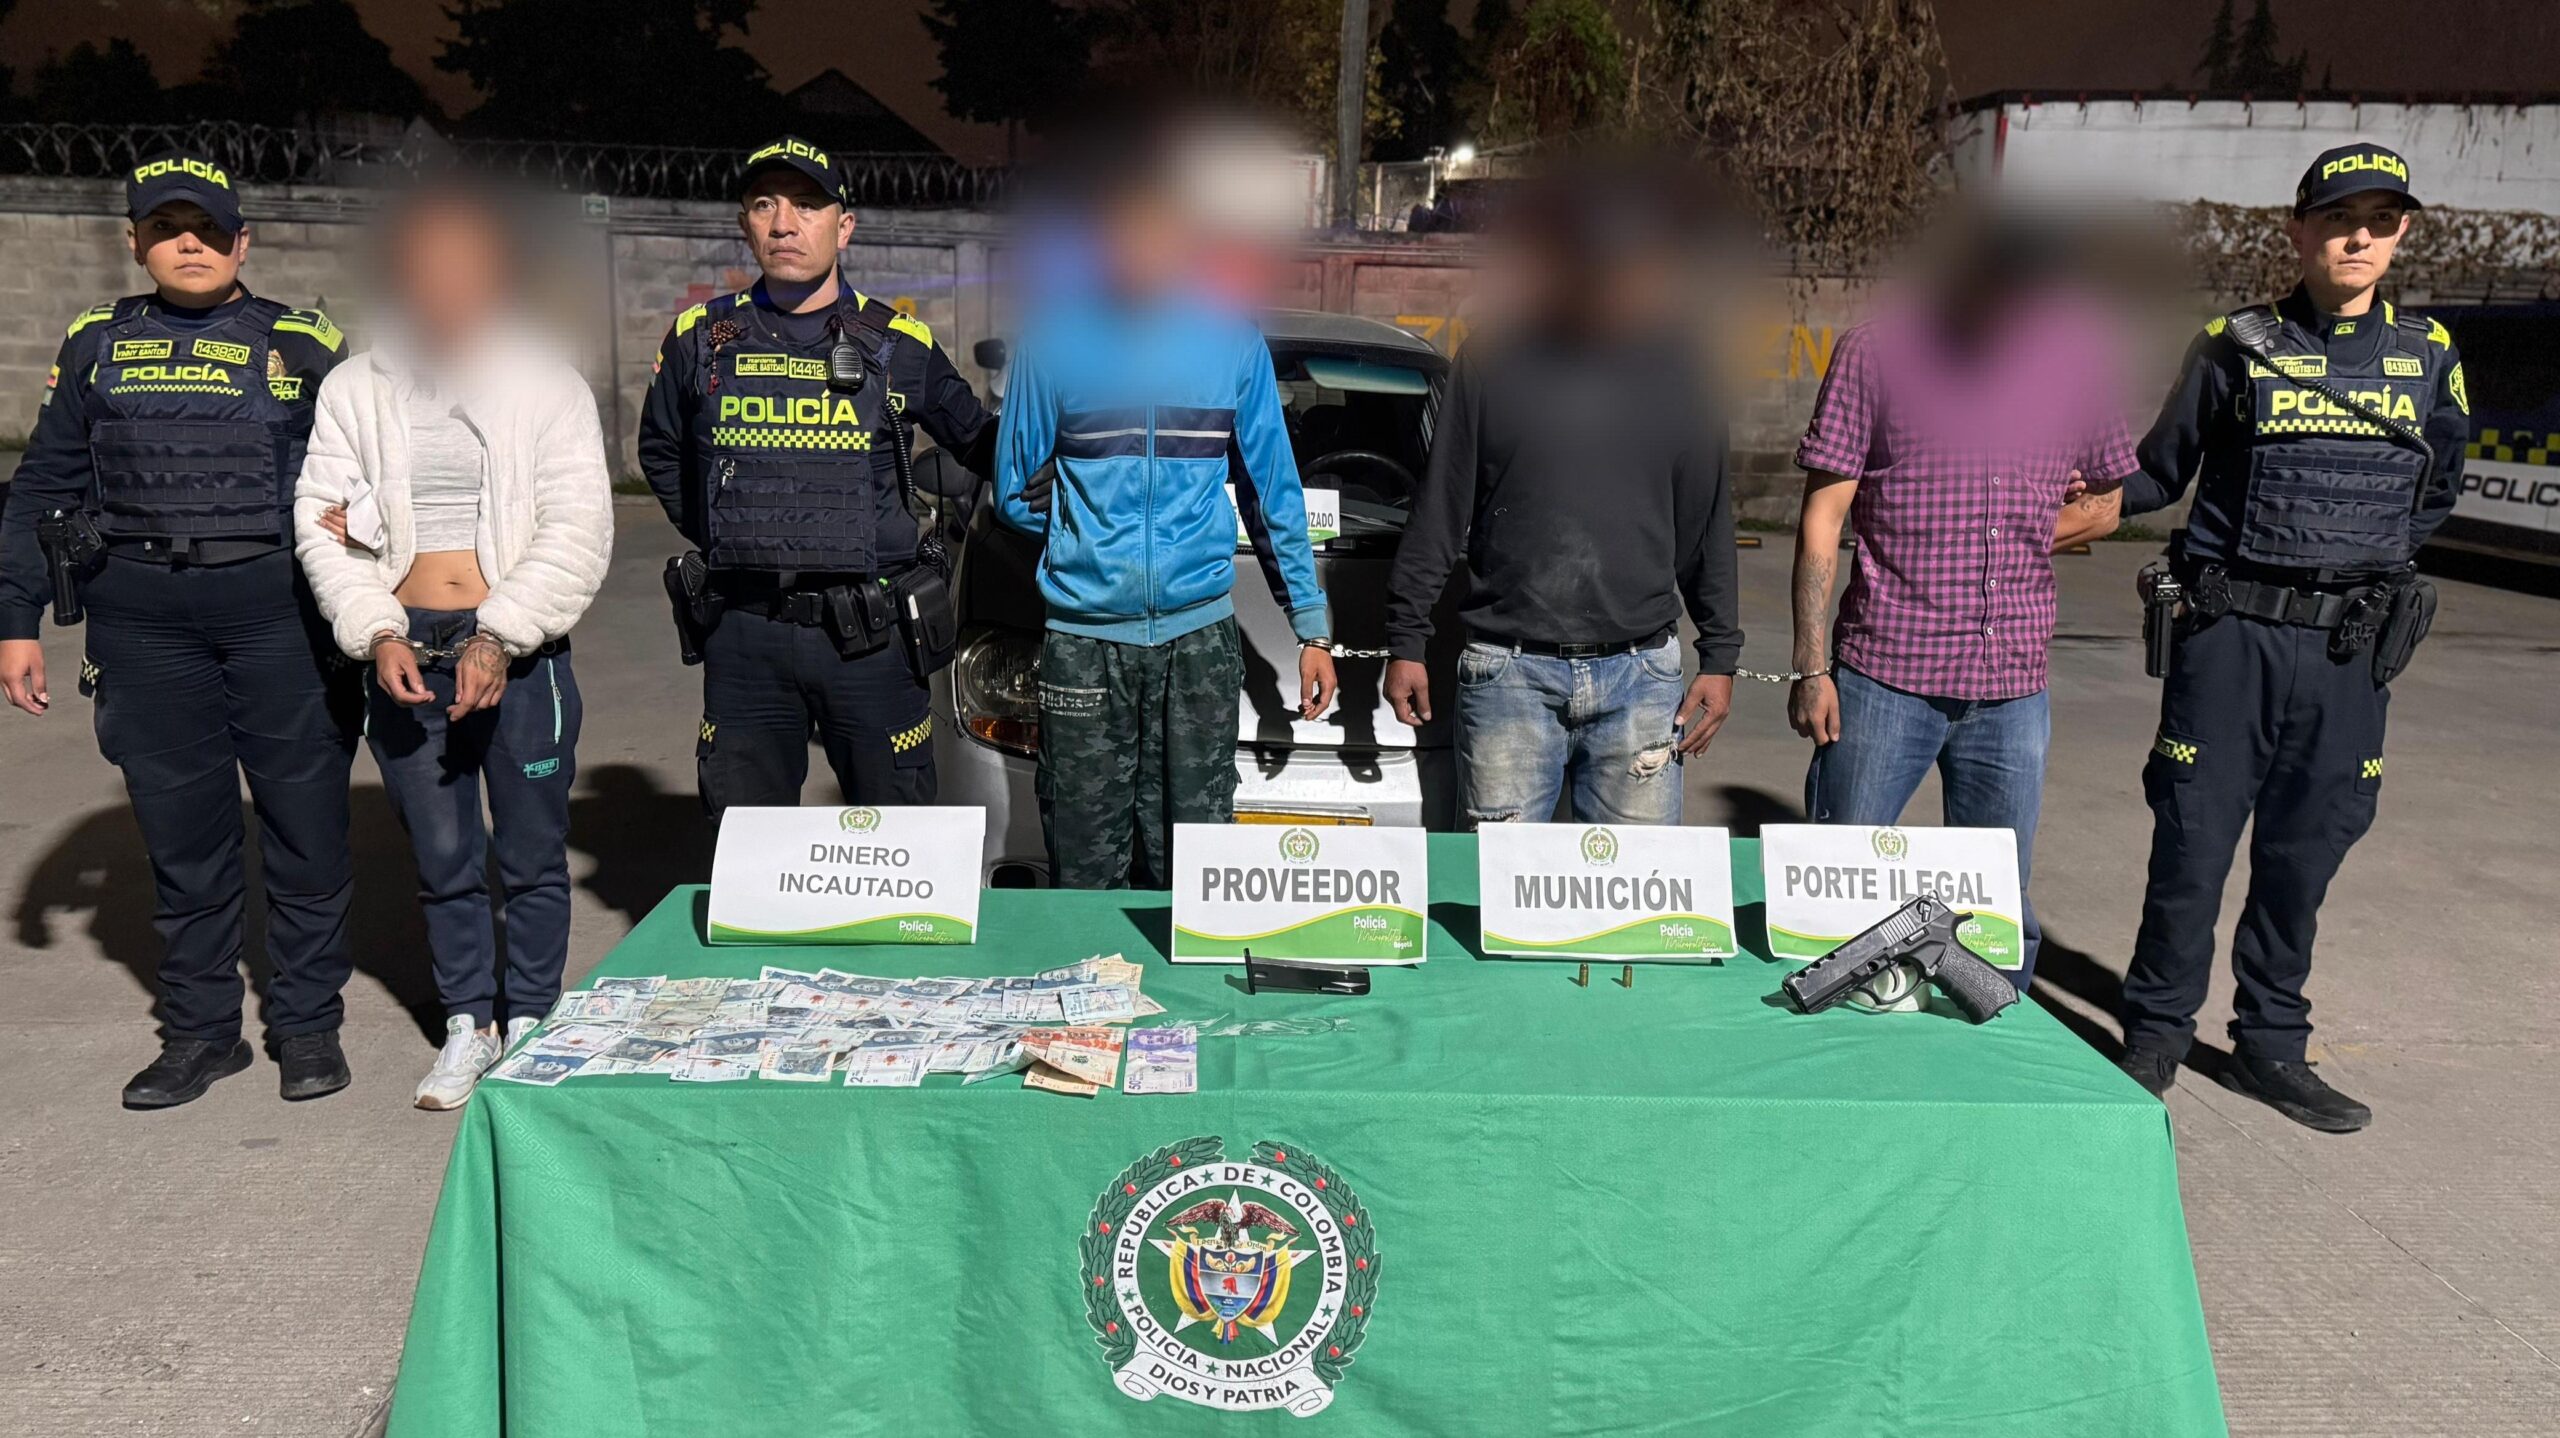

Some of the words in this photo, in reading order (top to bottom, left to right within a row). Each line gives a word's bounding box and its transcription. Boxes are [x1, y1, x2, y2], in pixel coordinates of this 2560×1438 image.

[747, 139, 828, 170] POLICÍA
[2323, 154, 2407, 182] POLICÍA
[134, 158, 229, 189] POLICÍA
[198, 343, 245, 361] 143920
[121, 363, 230, 383] POLICÍA
[792, 362, 827, 377] 14412
[720, 389, 859, 425] POLICÍA
[2459, 474, 2560, 507] POLIC
[810, 844, 910, 867] DINERO
[779, 872, 934, 899] INCAUTADO
[1202, 867, 1401, 904] PROVEEDOR
[1514, 869, 1693, 912] MUNICIÓN
[1785, 865, 1878, 900] PORTE
[1889, 868, 1993, 905] ILEGAL
[899, 920, 933, 932] Policía
[1353, 915, 1387, 929] Policía
[1660, 924, 1693, 937] Policía
[1956, 921, 1982, 934] olicía
[1118, 1174, 1200, 1278] REPÚBLICA
[1223, 1166, 1255, 1183] DE
[1280, 1182, 1343, 1294] COLOMBIA
[1127, 1305, 1198, 1369] POLICÍA
[1225, 1320, 1329, 1378] NACIONAL
[1149, 1363, 1200, 1396] DIOS
[1203, 1385, 1217, 1401] Y
[1223, 1379, 1301, 1404] PATRIA
